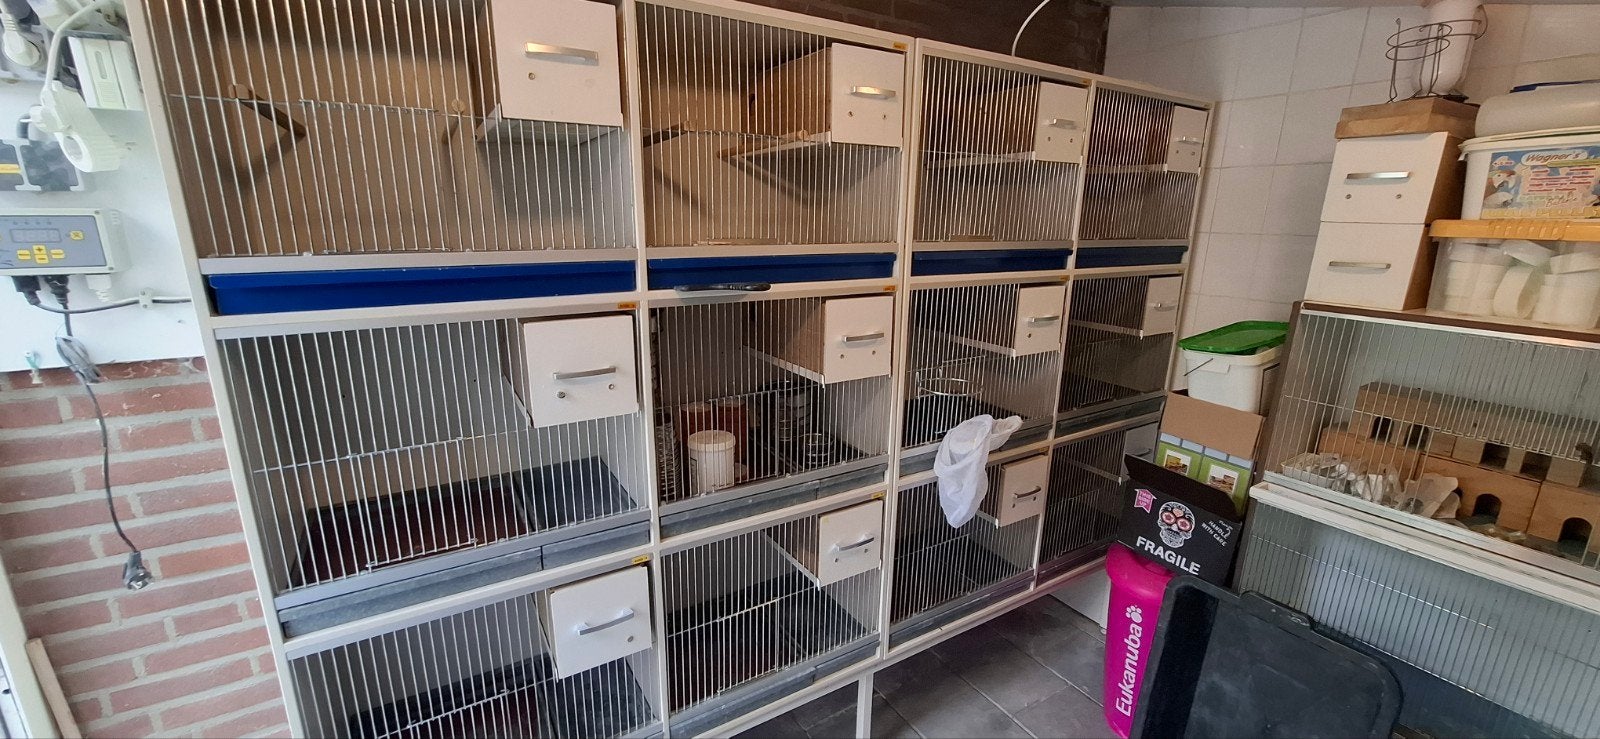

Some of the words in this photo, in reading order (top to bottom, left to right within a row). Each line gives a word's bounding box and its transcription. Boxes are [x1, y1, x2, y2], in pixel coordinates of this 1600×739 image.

[1526, 151, 1581, 163] Wagner's
[1213, 533, 1228, 547] CARE
[1136, 536, 1201, 576] FRAGILE
[1115, 624, 1143, 717] Eukanuba
